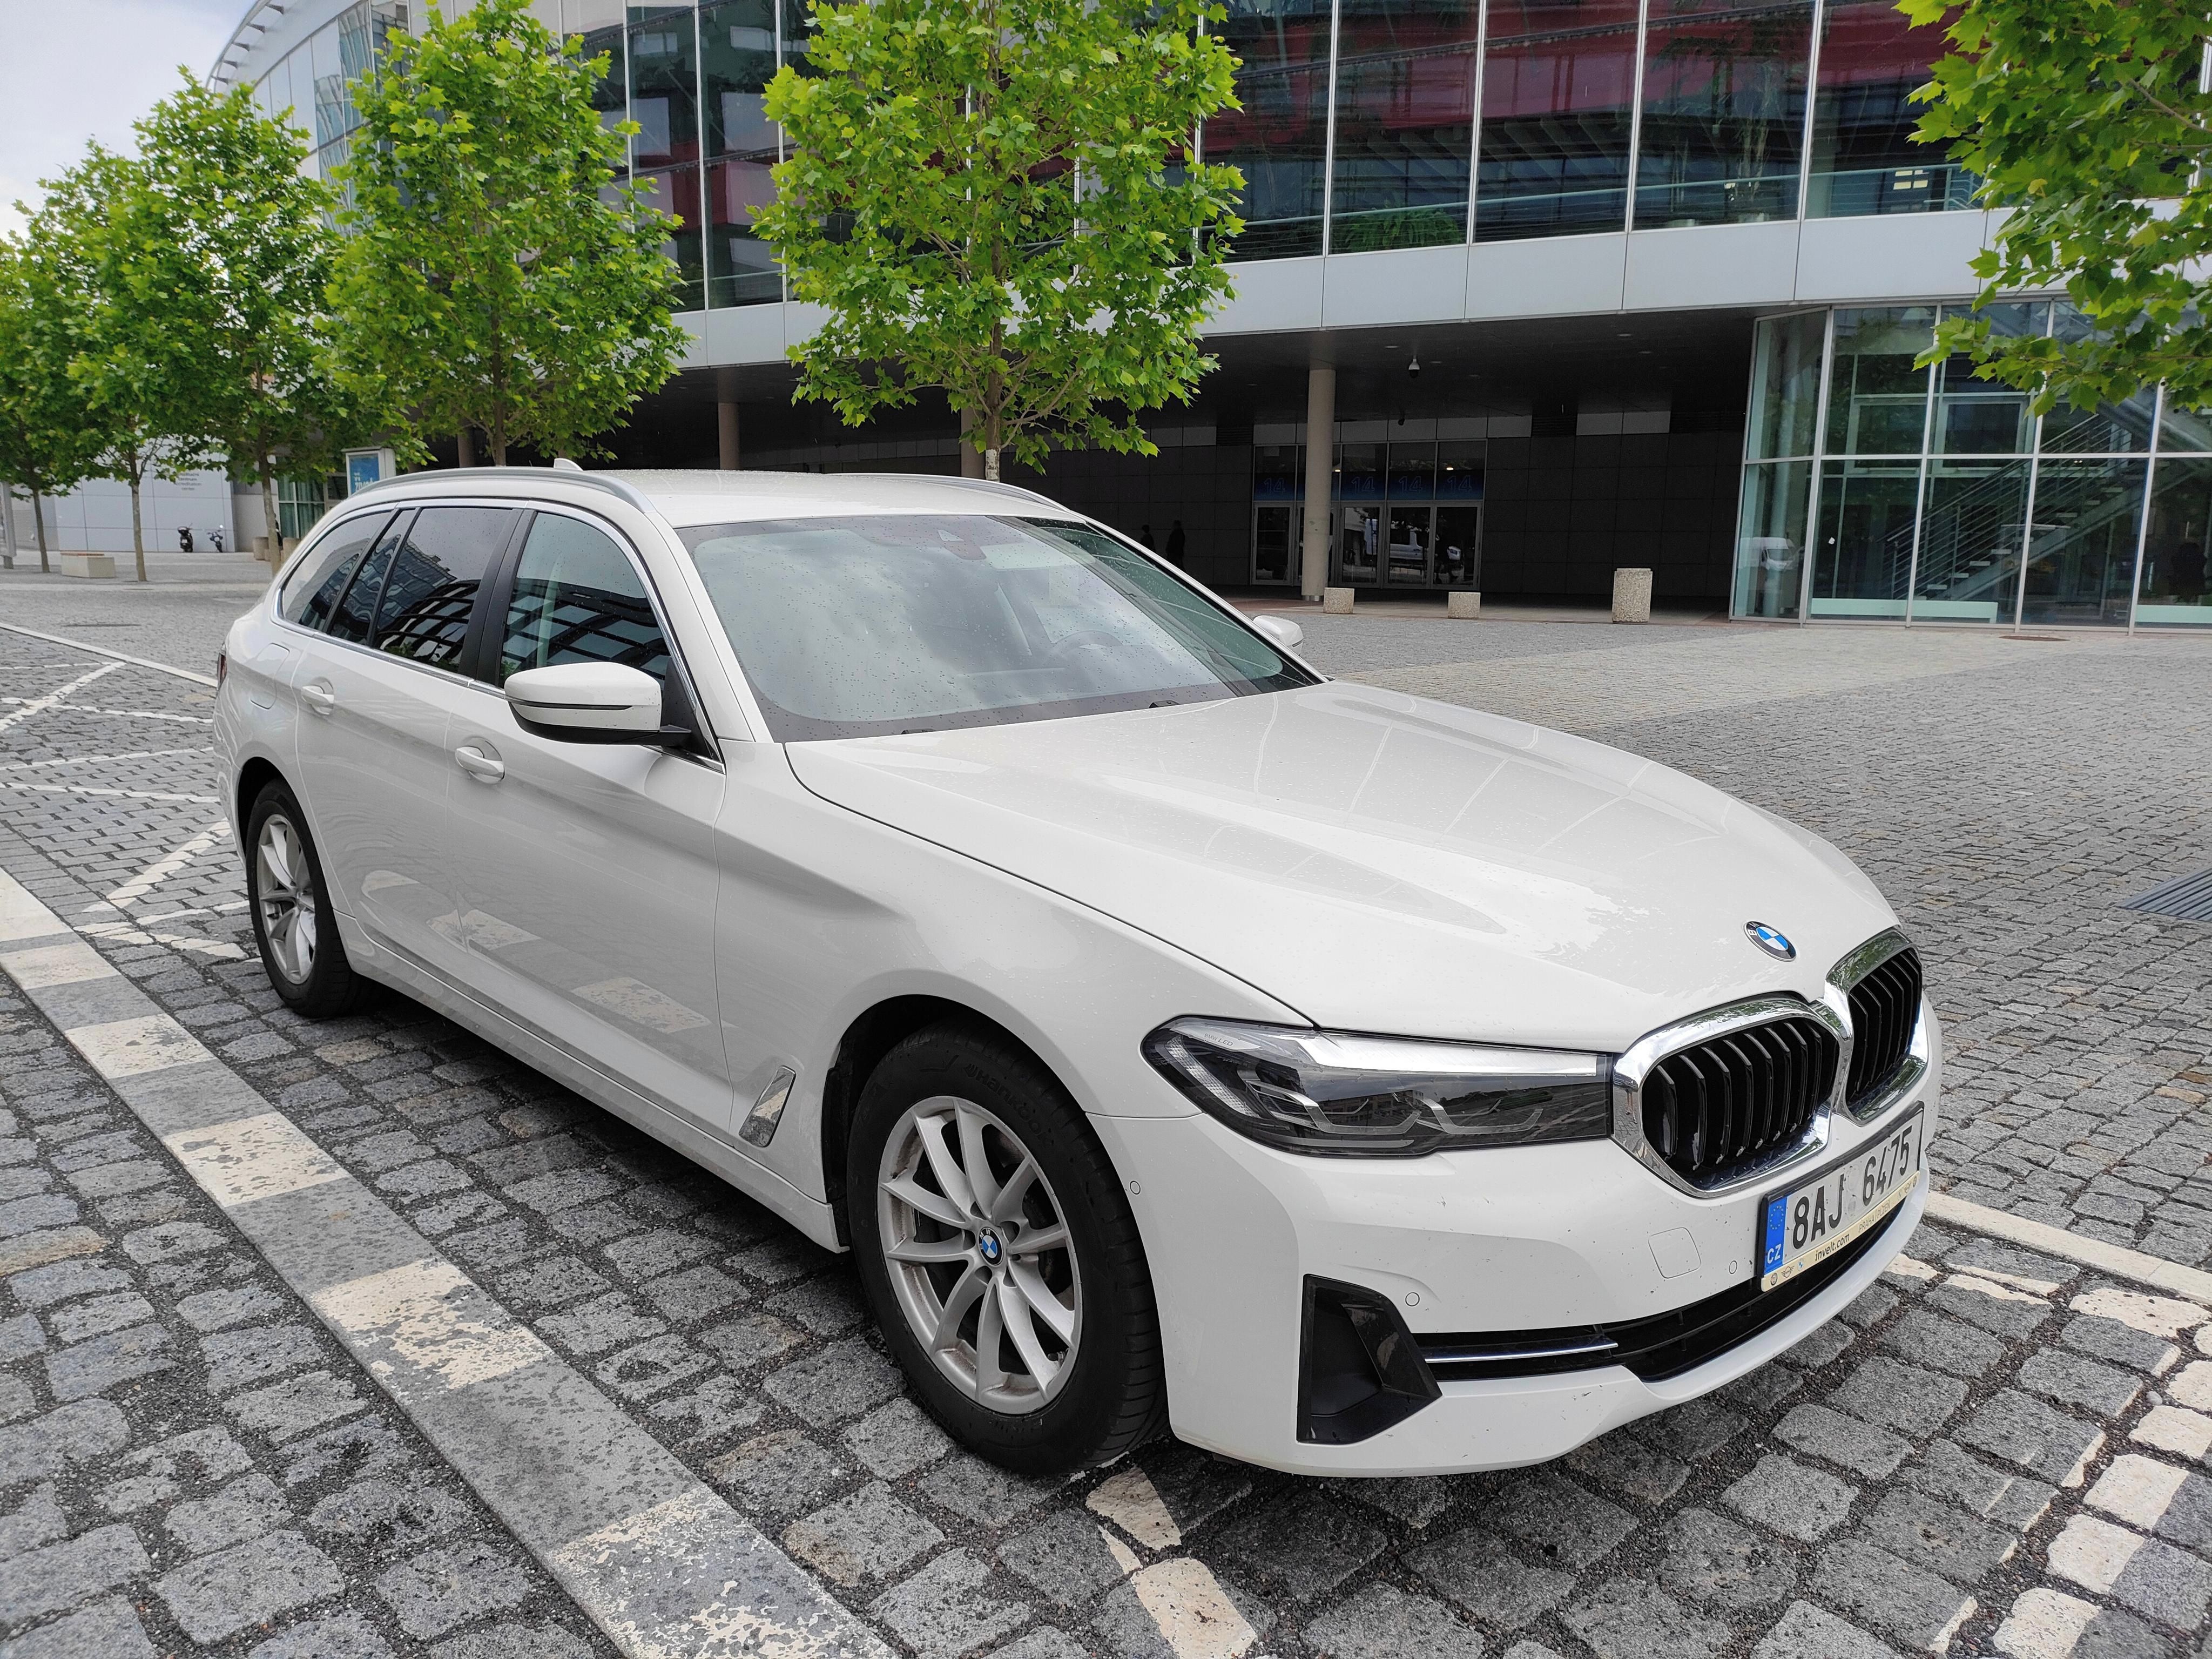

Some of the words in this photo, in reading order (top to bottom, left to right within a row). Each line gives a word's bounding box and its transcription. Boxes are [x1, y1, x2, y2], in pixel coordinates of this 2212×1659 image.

[1263, 477, 1286, 493] 14
[1351, 476, 1375, 493] 14
[1398, 475, 1422, 493] 14
[1447, 475, 1473, 493] 14
[1204, 1033, 1218, 1041] BMW
[1218, 1038, 1233, 1046] LED
[1792, 1173, 1844, 1250] 8AJ
[1863, 1125, 1913, 1206] 6475
[979, 1228, 991, 1250] BMW
[1815, 1233, 1850, 1261] invelt.com
[1767, 1244, 1781, 1264] CZ
